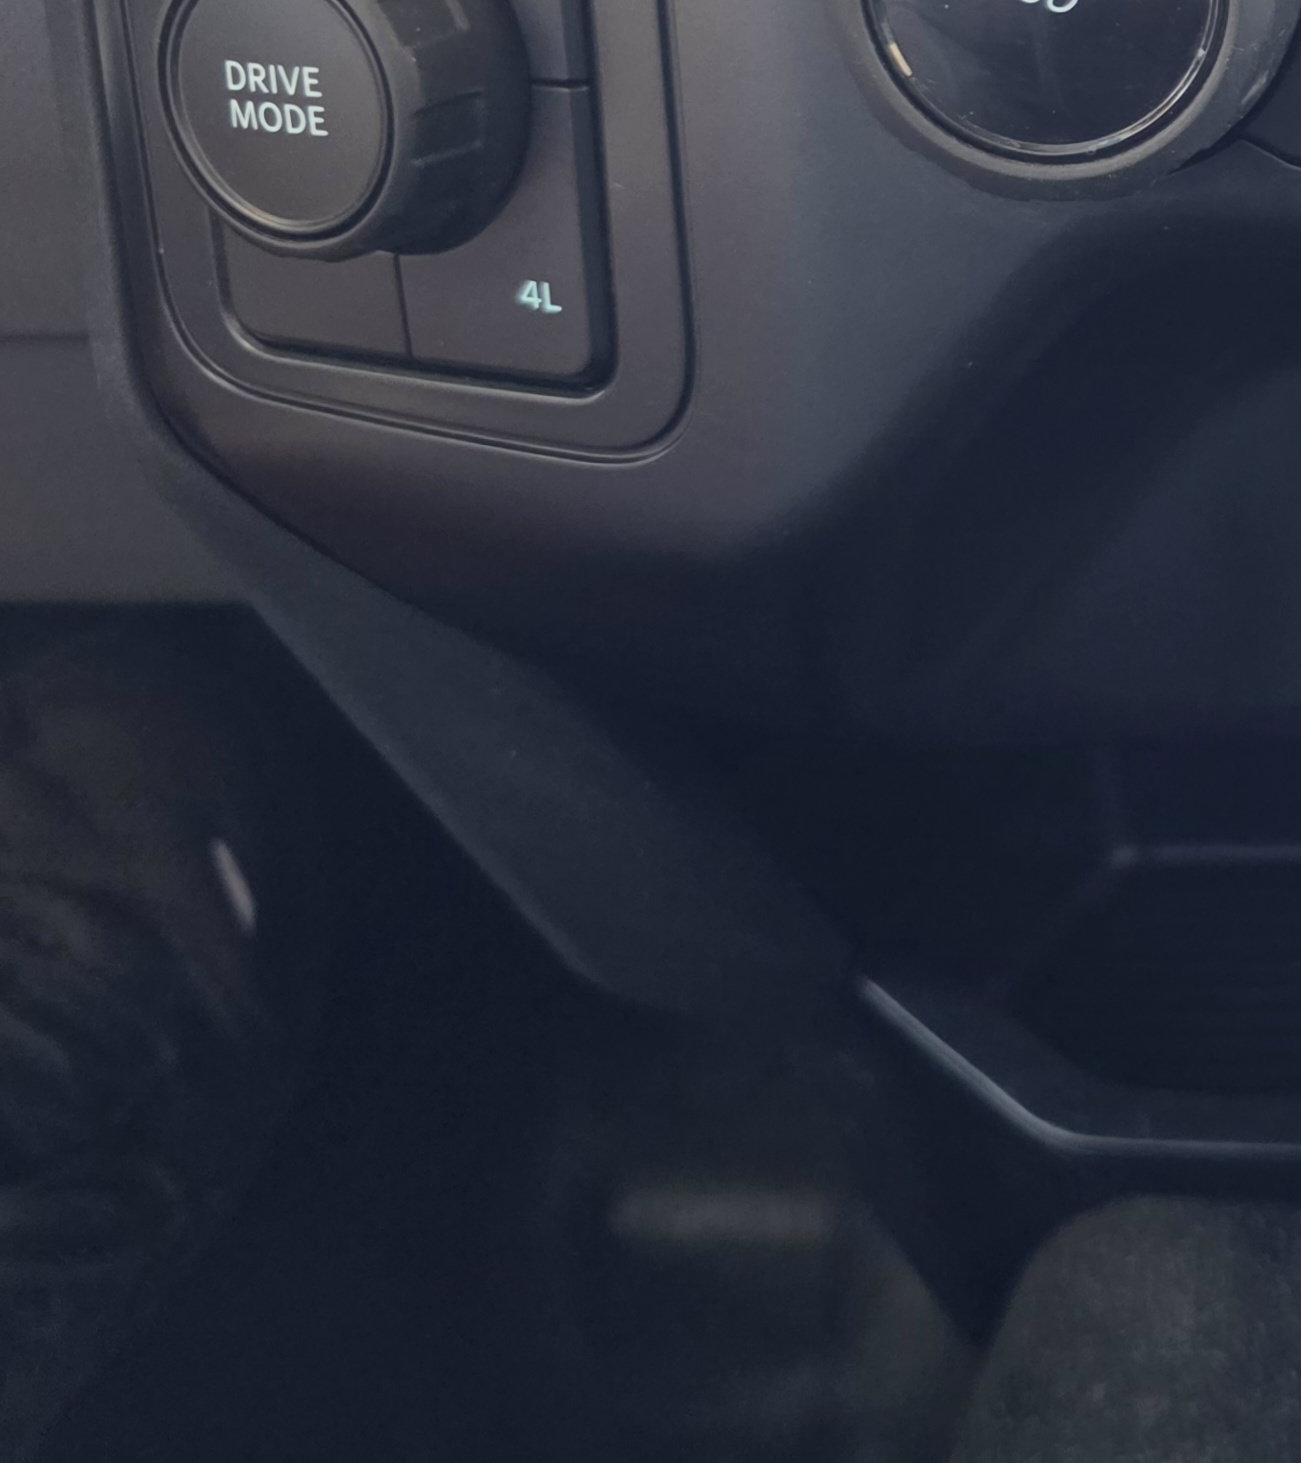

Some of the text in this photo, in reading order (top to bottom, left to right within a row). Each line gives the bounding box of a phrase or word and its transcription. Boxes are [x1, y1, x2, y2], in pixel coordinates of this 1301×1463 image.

[223, 59, 322, 98] DRIVE
[229, 99, 329, 138] MODE
[516, 279, 563, 315] 4L
